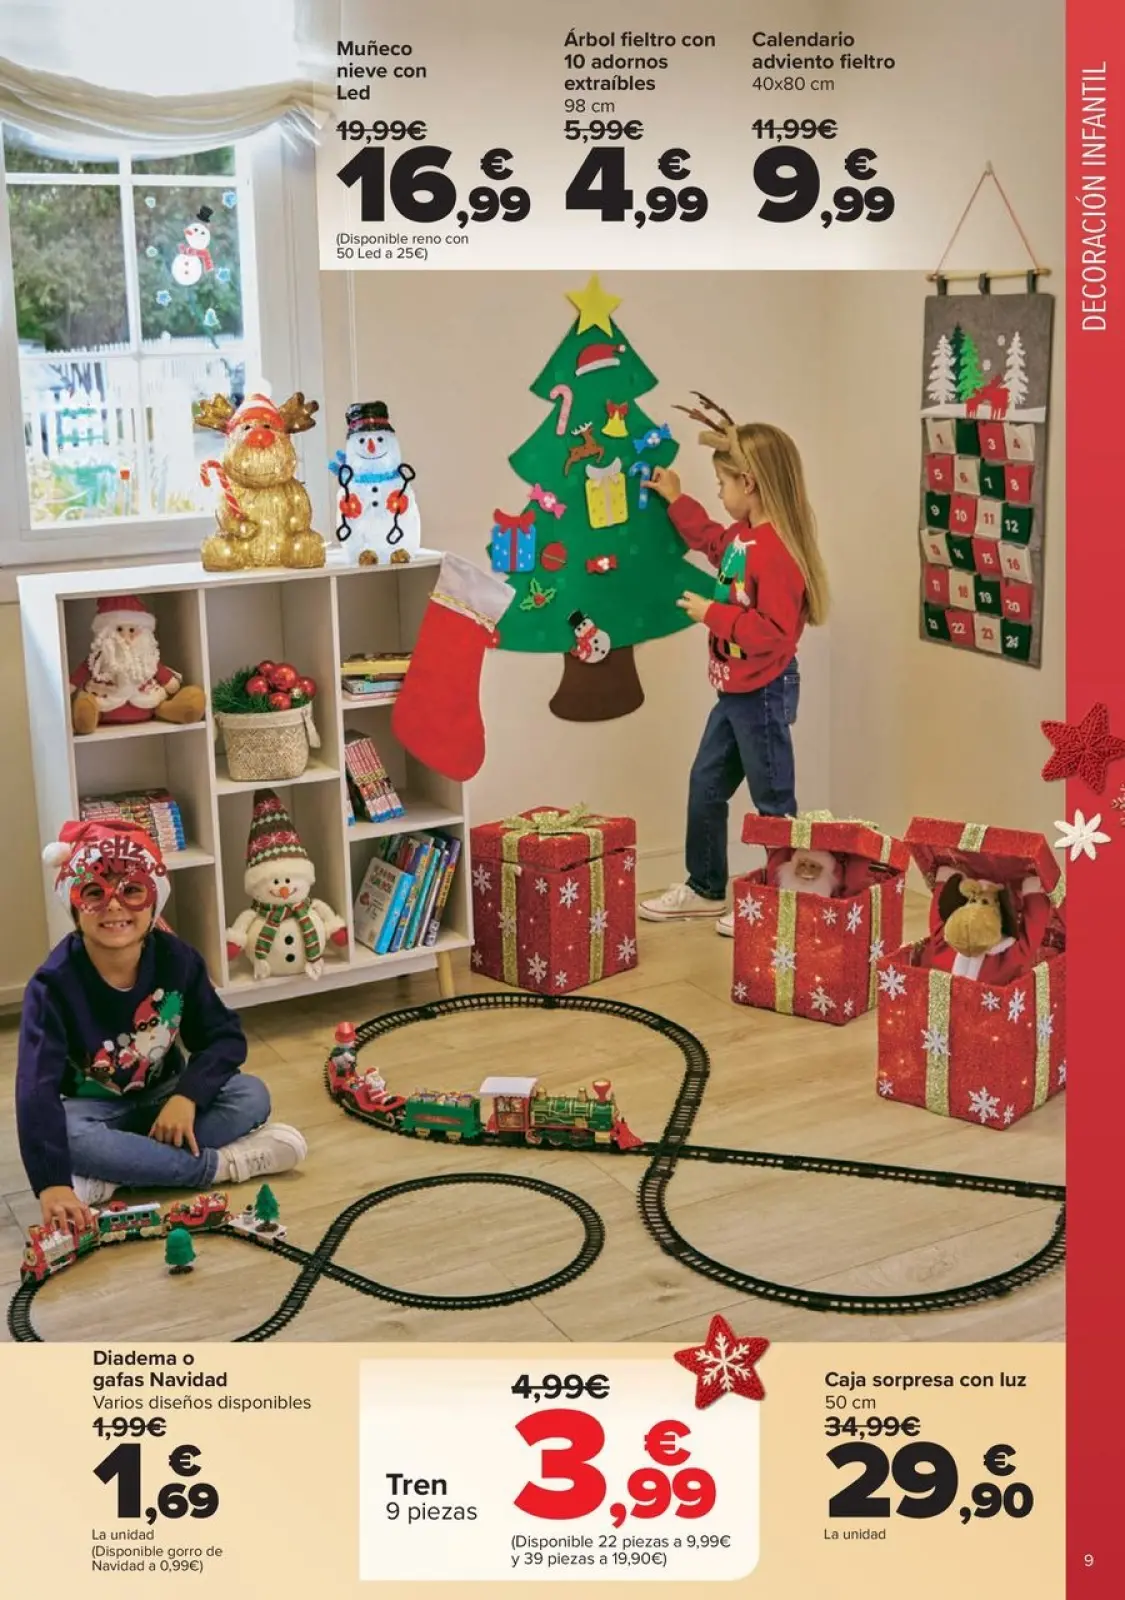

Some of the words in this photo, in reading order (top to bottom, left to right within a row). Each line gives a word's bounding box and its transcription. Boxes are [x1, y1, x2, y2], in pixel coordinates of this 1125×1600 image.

[564, 28, 614, 47] Árbol
[621, 31, 675, 46] fieltro
[682, 36, 715, 46] con
[753, 31, 854, 47] Calendario
[338, 40, 412, 56] Muñeco
[565, 54, 585, 69] 10
[591, 54, 668, 69] adornos
[752, 54, 834, 69] adviento
[840, 53, 895, 69] fieltro
[338, 63, 386, 78] nieve
[394, 67, 426, 78] con
[565, 75, 655, 90] extraíbles
[753, 77, 805, 90] 40x80
[811, 80, 834, 90] cm
[337, 85, 370, 100] Led
[565, 99, 585, 112] 98
[591, 102, 614, 113] cm
[1082, 62, 1106, 165] INFANTIL
[336, 120, 427, 142] 19,99€
[564, 120, 644, 142] 5,99€
[752, 119, 838, 142] 11,99€
[336, 233, 408, 246] (Disponible
[413, 236, 441, 244] reno
[445, 235, 468, 244] con
[337, 248, 354, 259] 50
[358, 248, 381, 258] Led
[385, 250, 392, 259] a
[397, 248, 427, 260] 25€)
[1076, 176, 1106, 330] DECORACIÓN
[988, 438, 996, 450] 3
[933, 468, 943, 480] 5
[984, 477, 993, 489] 7
[955, 509, 968, 523] 10
[983, 512, 995, 525] 11
[1004, 519, 1019, 533] 12
[1007, 558, 1020, 570] 16
[978, 591, 992, 604] 19
[951, 622, 966, 634] 22
[94, 1350, 176, 1365] Diadema
[183, 1354, 194, 1365] o
[93, 1372, 144, 1390] gafas
[150, 1371, 227, 1387] Navidad
[511, 1374, 610, 1402] 4,99€
[825, 1371, 865, 1391] Caja
[873, 1376, 953, 1390] sorpresa
[960, 1376, 993, 1387] con
[1001, 1372, 1026, 1387] luz
[93, 1396, 143, 1409] Varios
[149, 1395, 212, 1409] diseños
[218, 1396, 311, 1412] disponibles
[826, 1395, 846, 1409] 50
[852, 1399, 875, 1409] cm
[92, 1417, 166, 1440] 1,99€
[825, 1416, 920, 1440] 34,99€
[386, 1474, 446, 1495] Tren
[387, 1502, 399, 1520] 9
[409, 1503, 477, 1524] piezas
[92, 1529, 106, 1540] La
[111, 1530, 154, 1540] unidad
[825, 1529, 838, 1539] La
[844, 1529, 885, 1539] unidad
[512, 1535, 593, 1550] (Disponible
[599, 1535, 616, 1547] 22
[623, 1536, 669, 1550] piezas
[674, 1539, 681, 1547] a
[687, 1535, 730, 1548] 9,99€
[92, 1546, 163, 1559] (Disponible
[167, 1548, 202, 1559] gorro
[206, 1546, 223, 1556] de
[512, 1556, 519, 1567] y
[525, 1552, 543, 1564] 39
[548, 1553, 594, 1567] piezas
[600, 1555, 607, 1564] a
[612, 1552, 666, 1567] 19,90€)
[1085, 1554, 1093, 1566] 9
[92, 1560, 144, 1571] Navidad
[149, 1563, 155, 1571] a
[160, 1560, 203, 1573] 0,99€)
